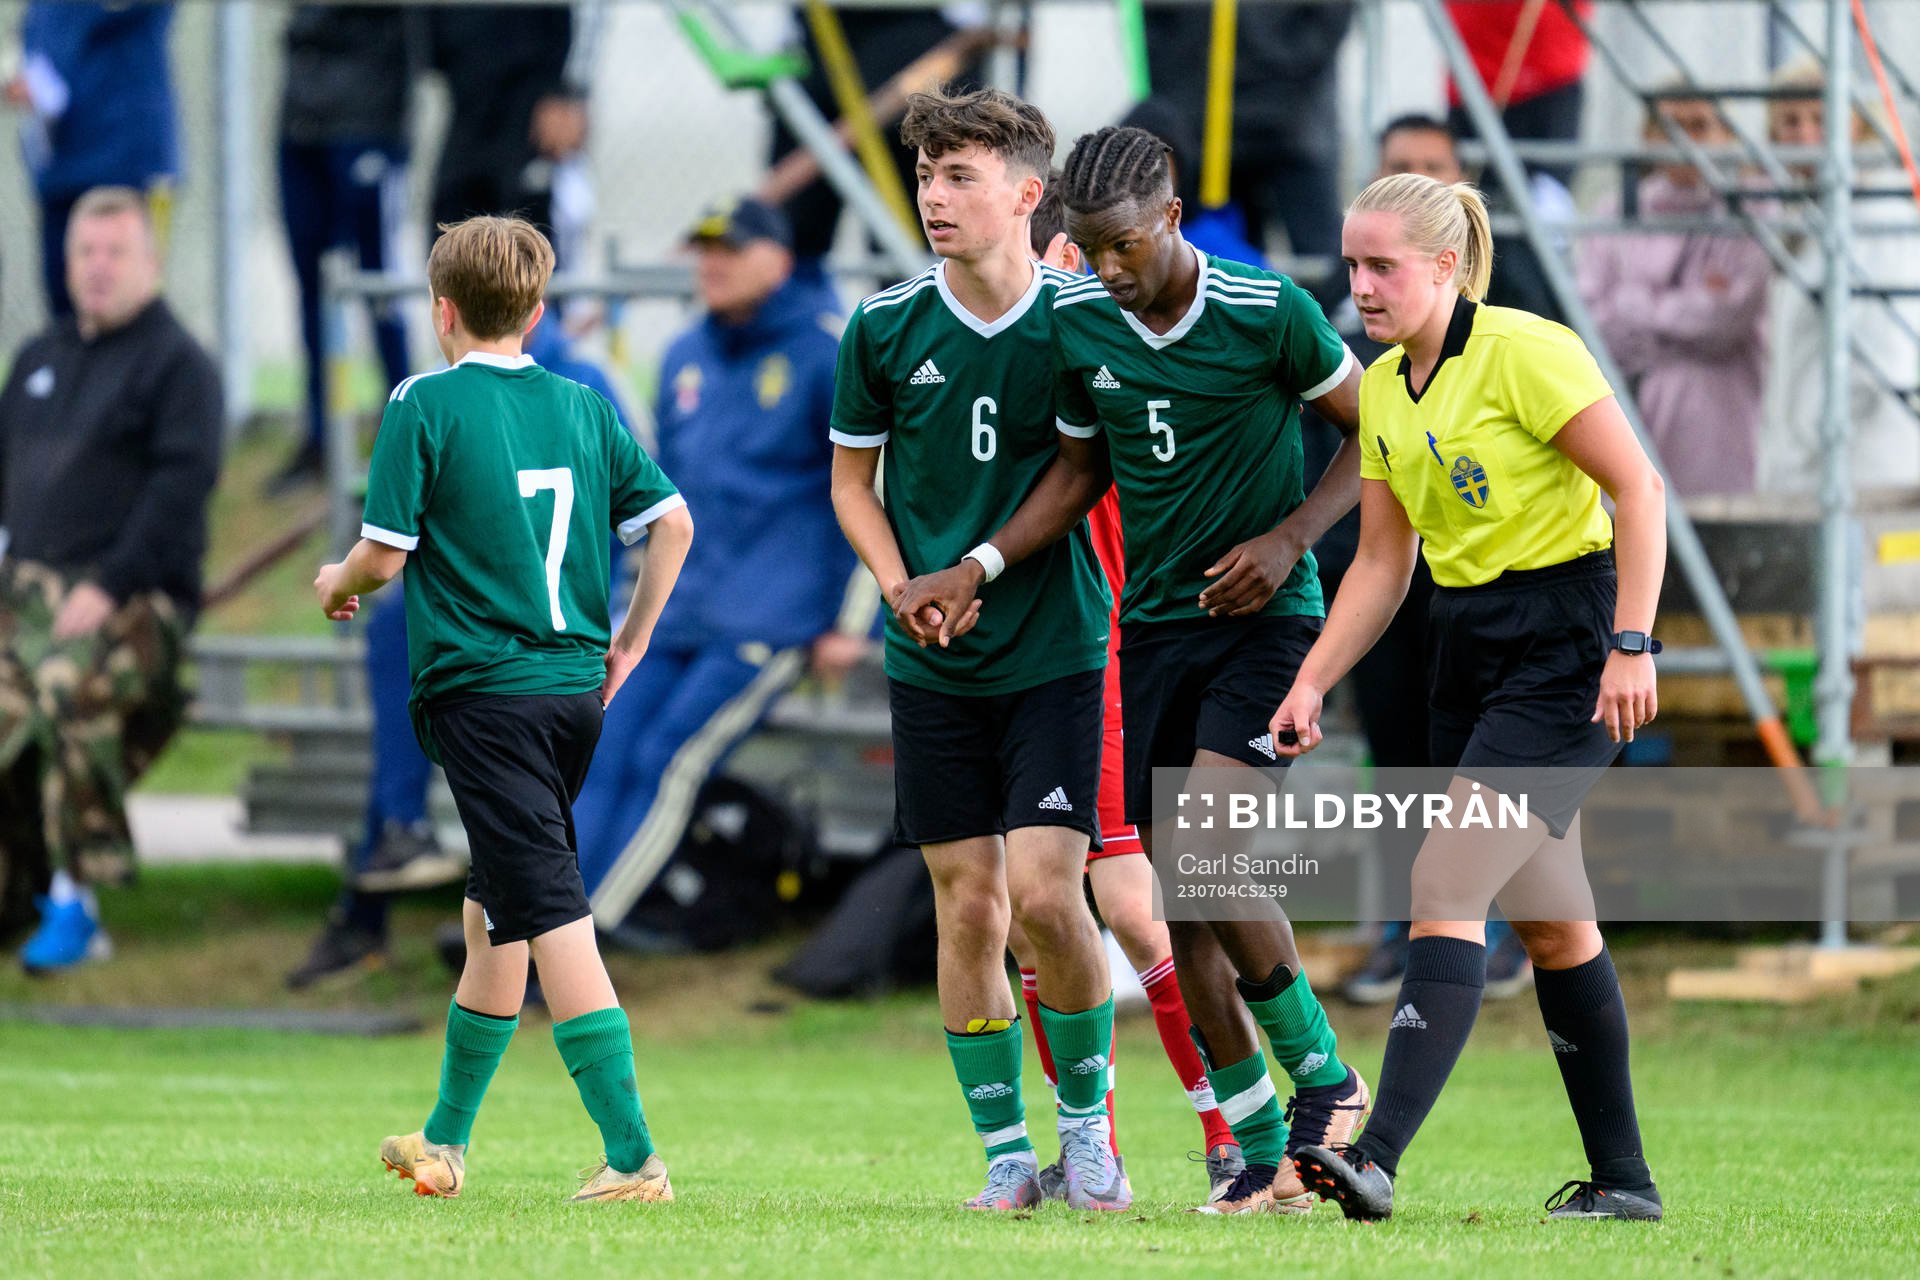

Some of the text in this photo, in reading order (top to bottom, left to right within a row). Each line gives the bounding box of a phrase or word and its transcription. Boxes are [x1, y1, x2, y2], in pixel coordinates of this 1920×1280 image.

[910, 374, 946, 385] adidas
[1092, 379, 1121, 389] adidas
[971, 396, 997, 462] 6
[1147, 399, 1176, 463] 5
[517, 467, 575, 631] 7
[1248, 740, 1277, 761] adidas
[1038, 801, 1073, 812] adidas
[969, 1086, 1014, 1100] adidas
